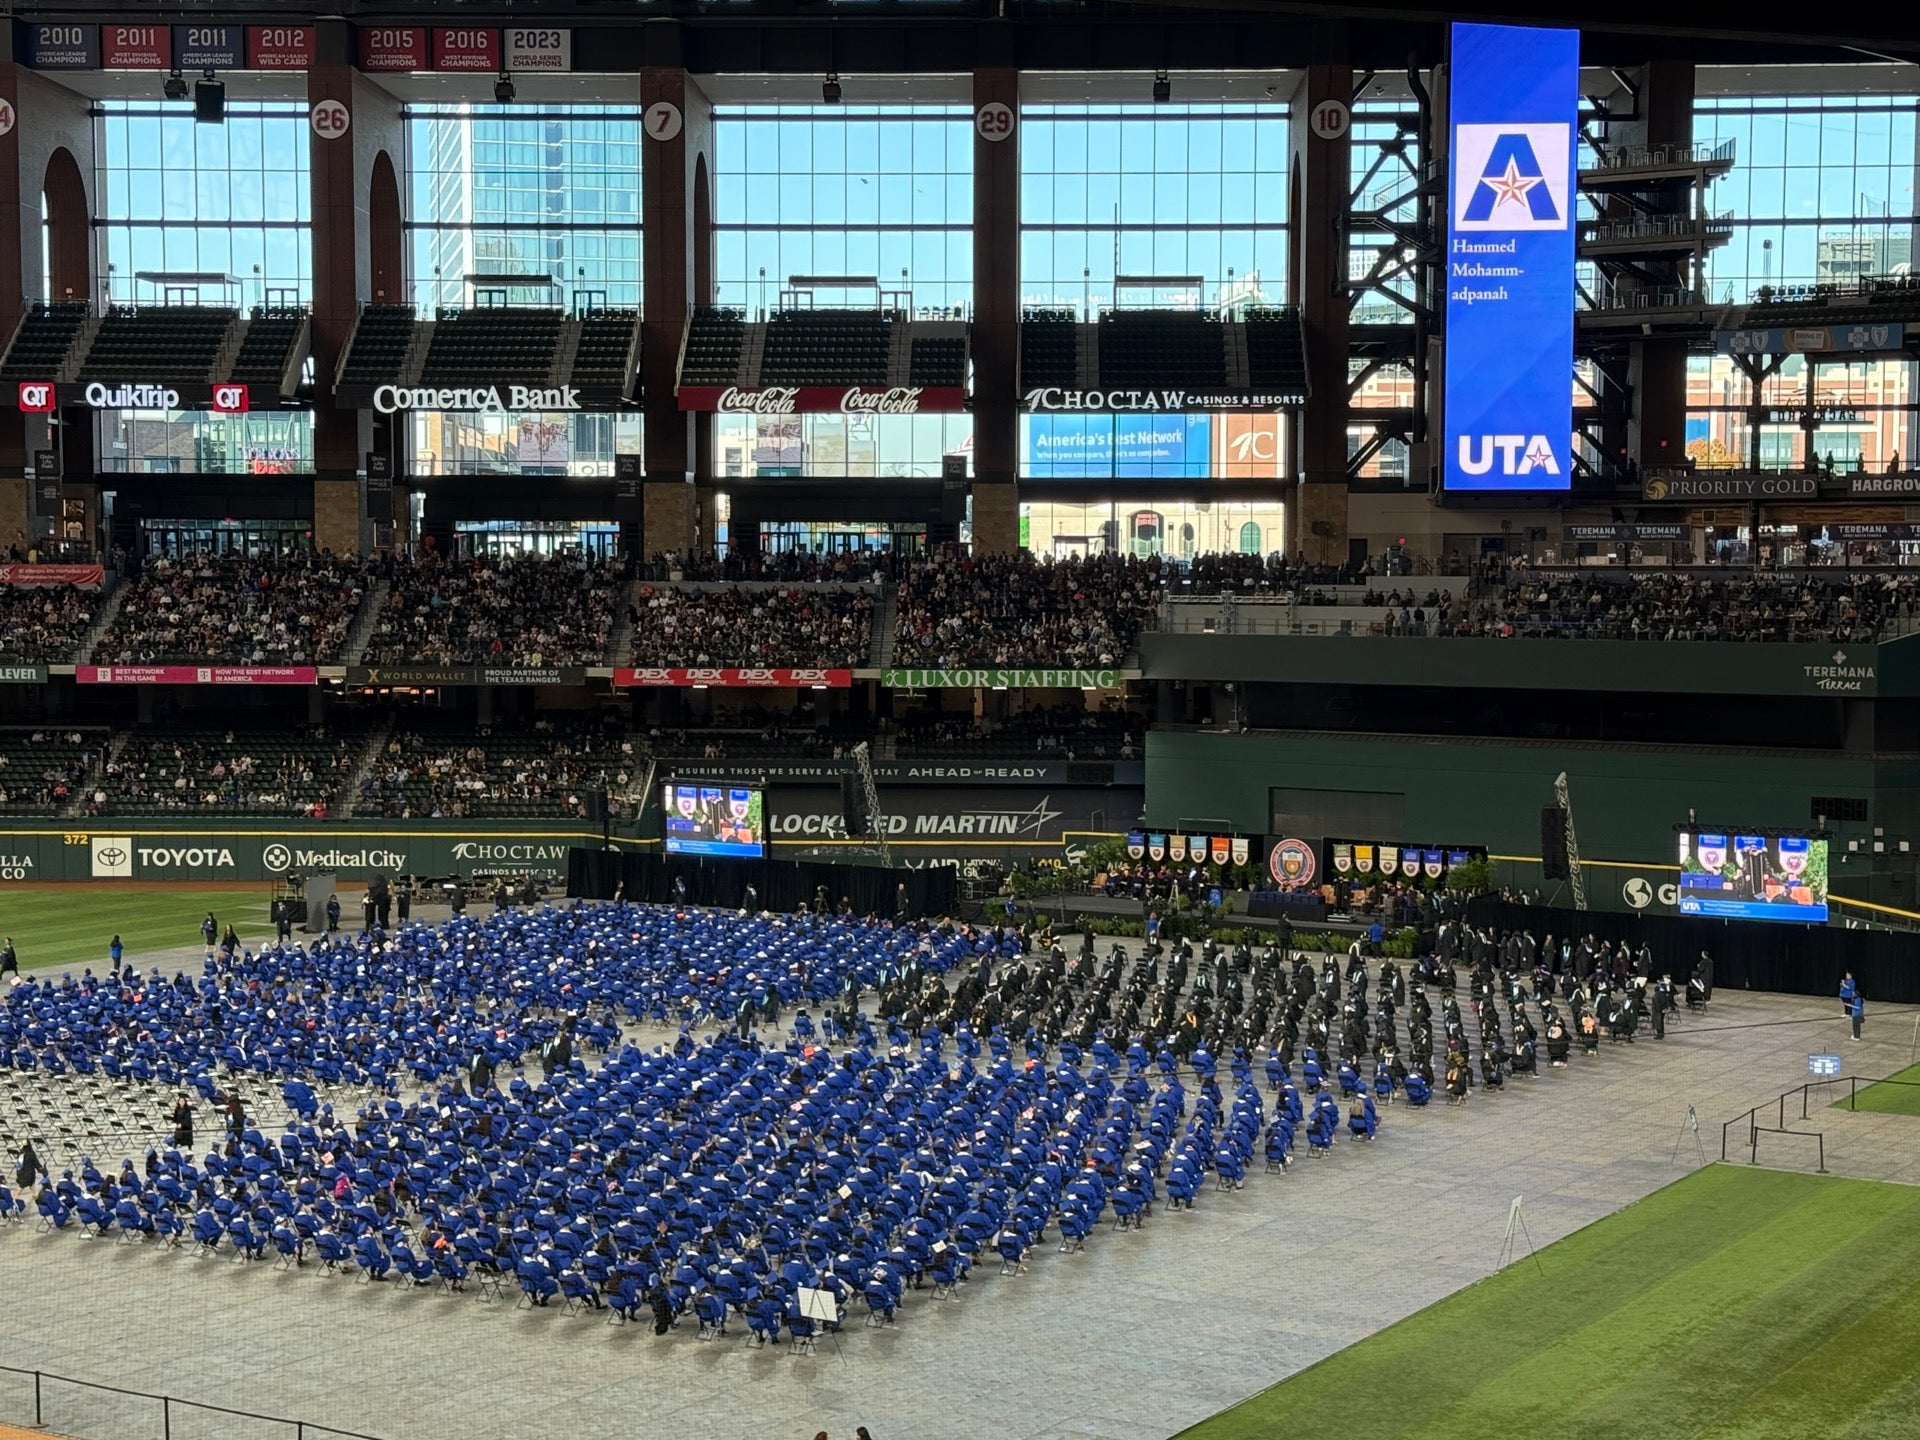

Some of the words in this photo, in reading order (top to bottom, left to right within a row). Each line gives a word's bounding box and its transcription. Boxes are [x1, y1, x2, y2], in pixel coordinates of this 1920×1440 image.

[39, 27, 82, 45] 2010
[117, 28, 154, 46] 2011
[188, 29, 227, 46] 2011
[262, 29, 305, 47] 2012
[371, 30, 414, 48] 2015
[445, 31, 488, 48] 2016
[514, 31, 561, 49] 2023
[36, 56, 86, 64] CHAMPIONS
[259, 58, 281, 66] WILD
[284, 58, 308, 66] CARD
[315, 108, 345, 131] 26
[656, 110, 672, 133] 7
[980, 111, 1010, 133] 29
[1318, 108, 1342, 131] 10
[1453, 239, 1516, 253] Hammed
[1452, 263, 1525, 277] Mohamm-
[1452, 286, 1508, 305] adpanah
[22, 386, 49, 408] QT
[85, 382, 180, 411] QuikTrip
[215, 387, 243, 409] QT
[509, 384, 582, 409] Bank
[717, 386, 801, 414] Coca-Cola
[840, 386, 924, 414] Coca-Cola
[1041, 388, 1185, 410] CHOCTAW
[1187, 395, 1238, 405] CASINOS
[1242, 395, 1250, 405] &
[1252, 395, 1304, 405] RESORTS
[1037, 432, 1105, 447] America's
[1137, 428, 1183, 445] Network
[1459, 434, 1561, 475] UTA
[1670, 480, 1756, 496] PRIORITY
[1762, 479, 1816, 495] GOLD
[1571, 527, 1616, 535] TEREMANA
[1635, 526, 1682, 535] TEREMANA
[1838, 525, 1888, 534] TEREMANA
[383, 672, 423, 680] WORLD
[426, 672, 466, 680] WALLET
[485, 669, 507, 677] PROUD
[508, 669, 546, 677] PARTNER
[547, 669, 559, 677] OF
[633, 669, 671, 679] DEX
[685, 669, 722, 679] DEX
[737, 669, 775, 679] DEX
[790, 669, 827, 679] DEX
[905, 669, 989, 687] LUXOR
[996, 669, 1114, 688] STAFFING
[1804, 666, 1875, 678] TEREMANA
[1816, 678, 1862, 690] TERRACE
[769, 767, 784, 776] WE
[789, 767, 823, 776] SERVE
[873, 767, 900, 776] STAY
[908, 767, 971, 777] AHEAD
[985, 767, 1047, 777] READY
[914, 815, 1020, 834] MARTIN
[64, 835, 88, 845] 372
[138, 848, 235, 867] TOYOTA
[463, 842, 566, 859] CHOCTAW
[295, 849, 367, 867] Medical
[368, 849, 407, 872] City
[2, 867, 26, 880] CO
[471, 868, 510, 876] CASINOS
